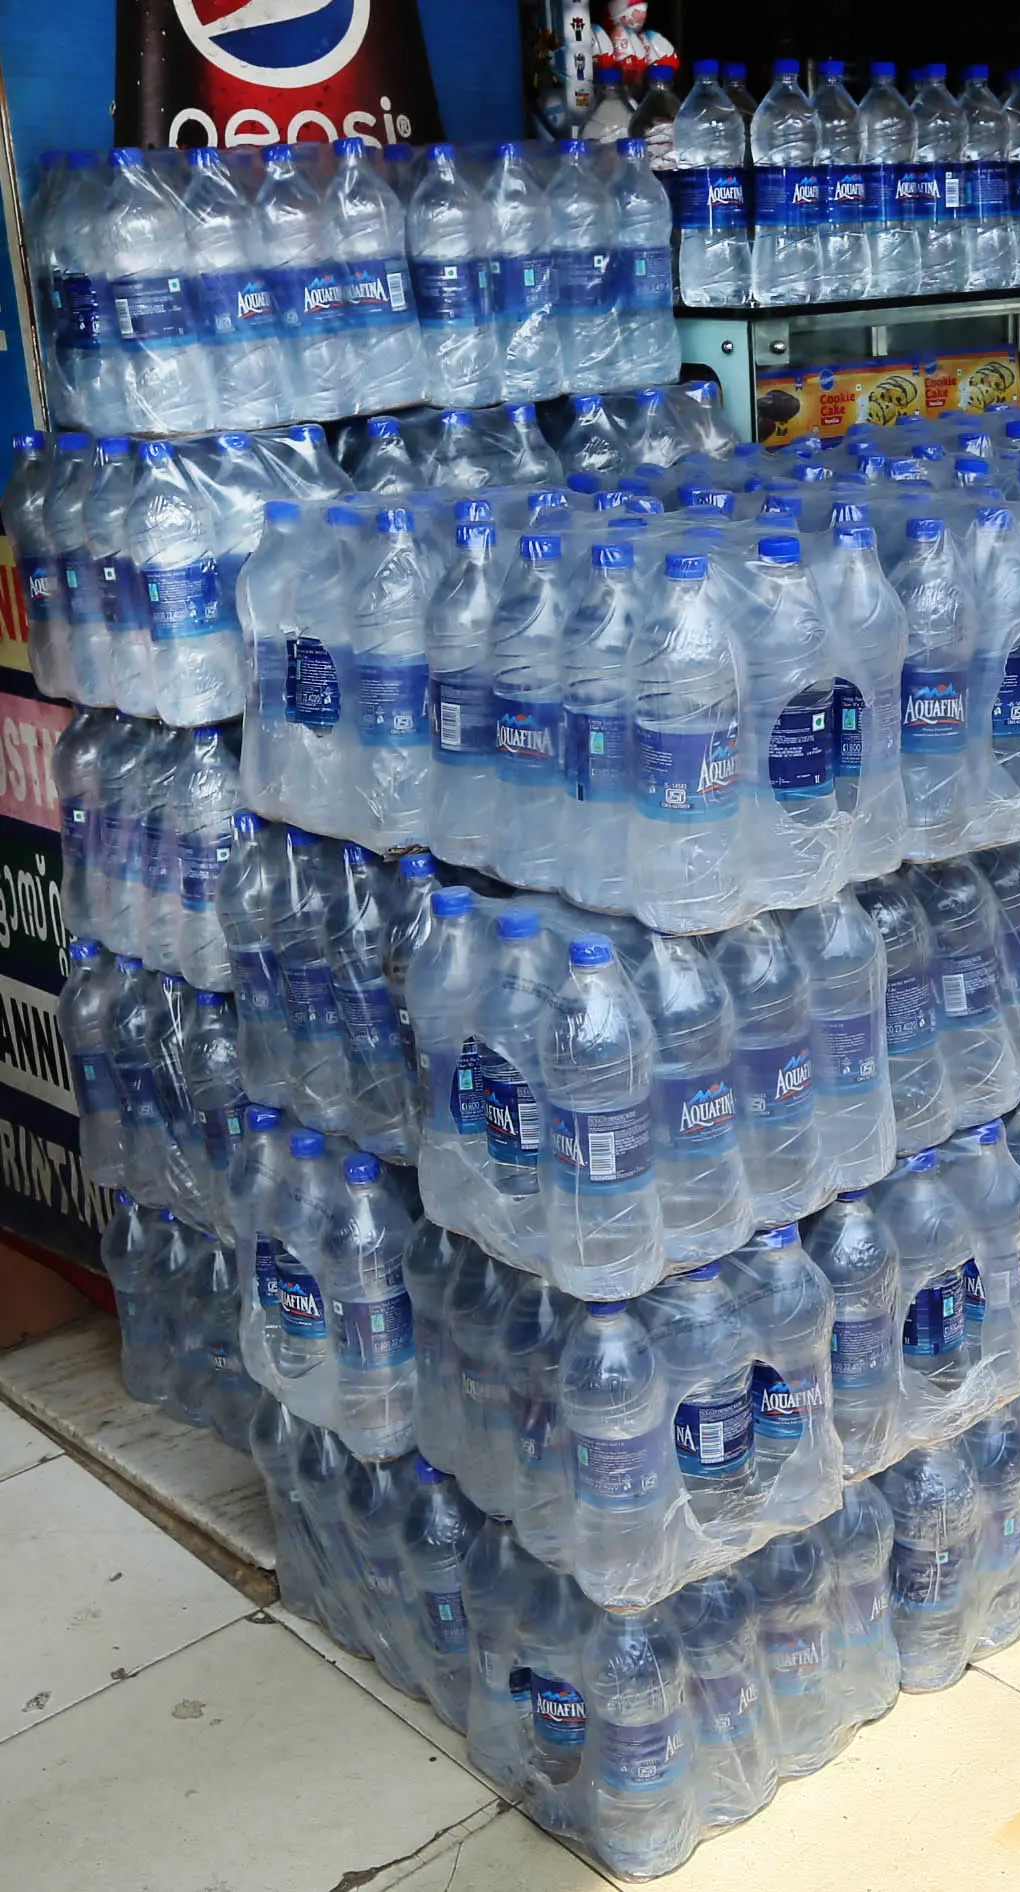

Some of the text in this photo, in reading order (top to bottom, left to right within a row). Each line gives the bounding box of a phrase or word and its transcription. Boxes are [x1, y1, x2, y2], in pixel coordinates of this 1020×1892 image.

[925, 376, 957, 388] Cookie
[820, 392, 856, 405] Cookie
[925, 388, 948, 399] Cake
[820, 405, 846, 416] Cake
[903, 694, 965, 725] AQUAFINA
[761, 1382, 824, 1414] AQUAFINA
